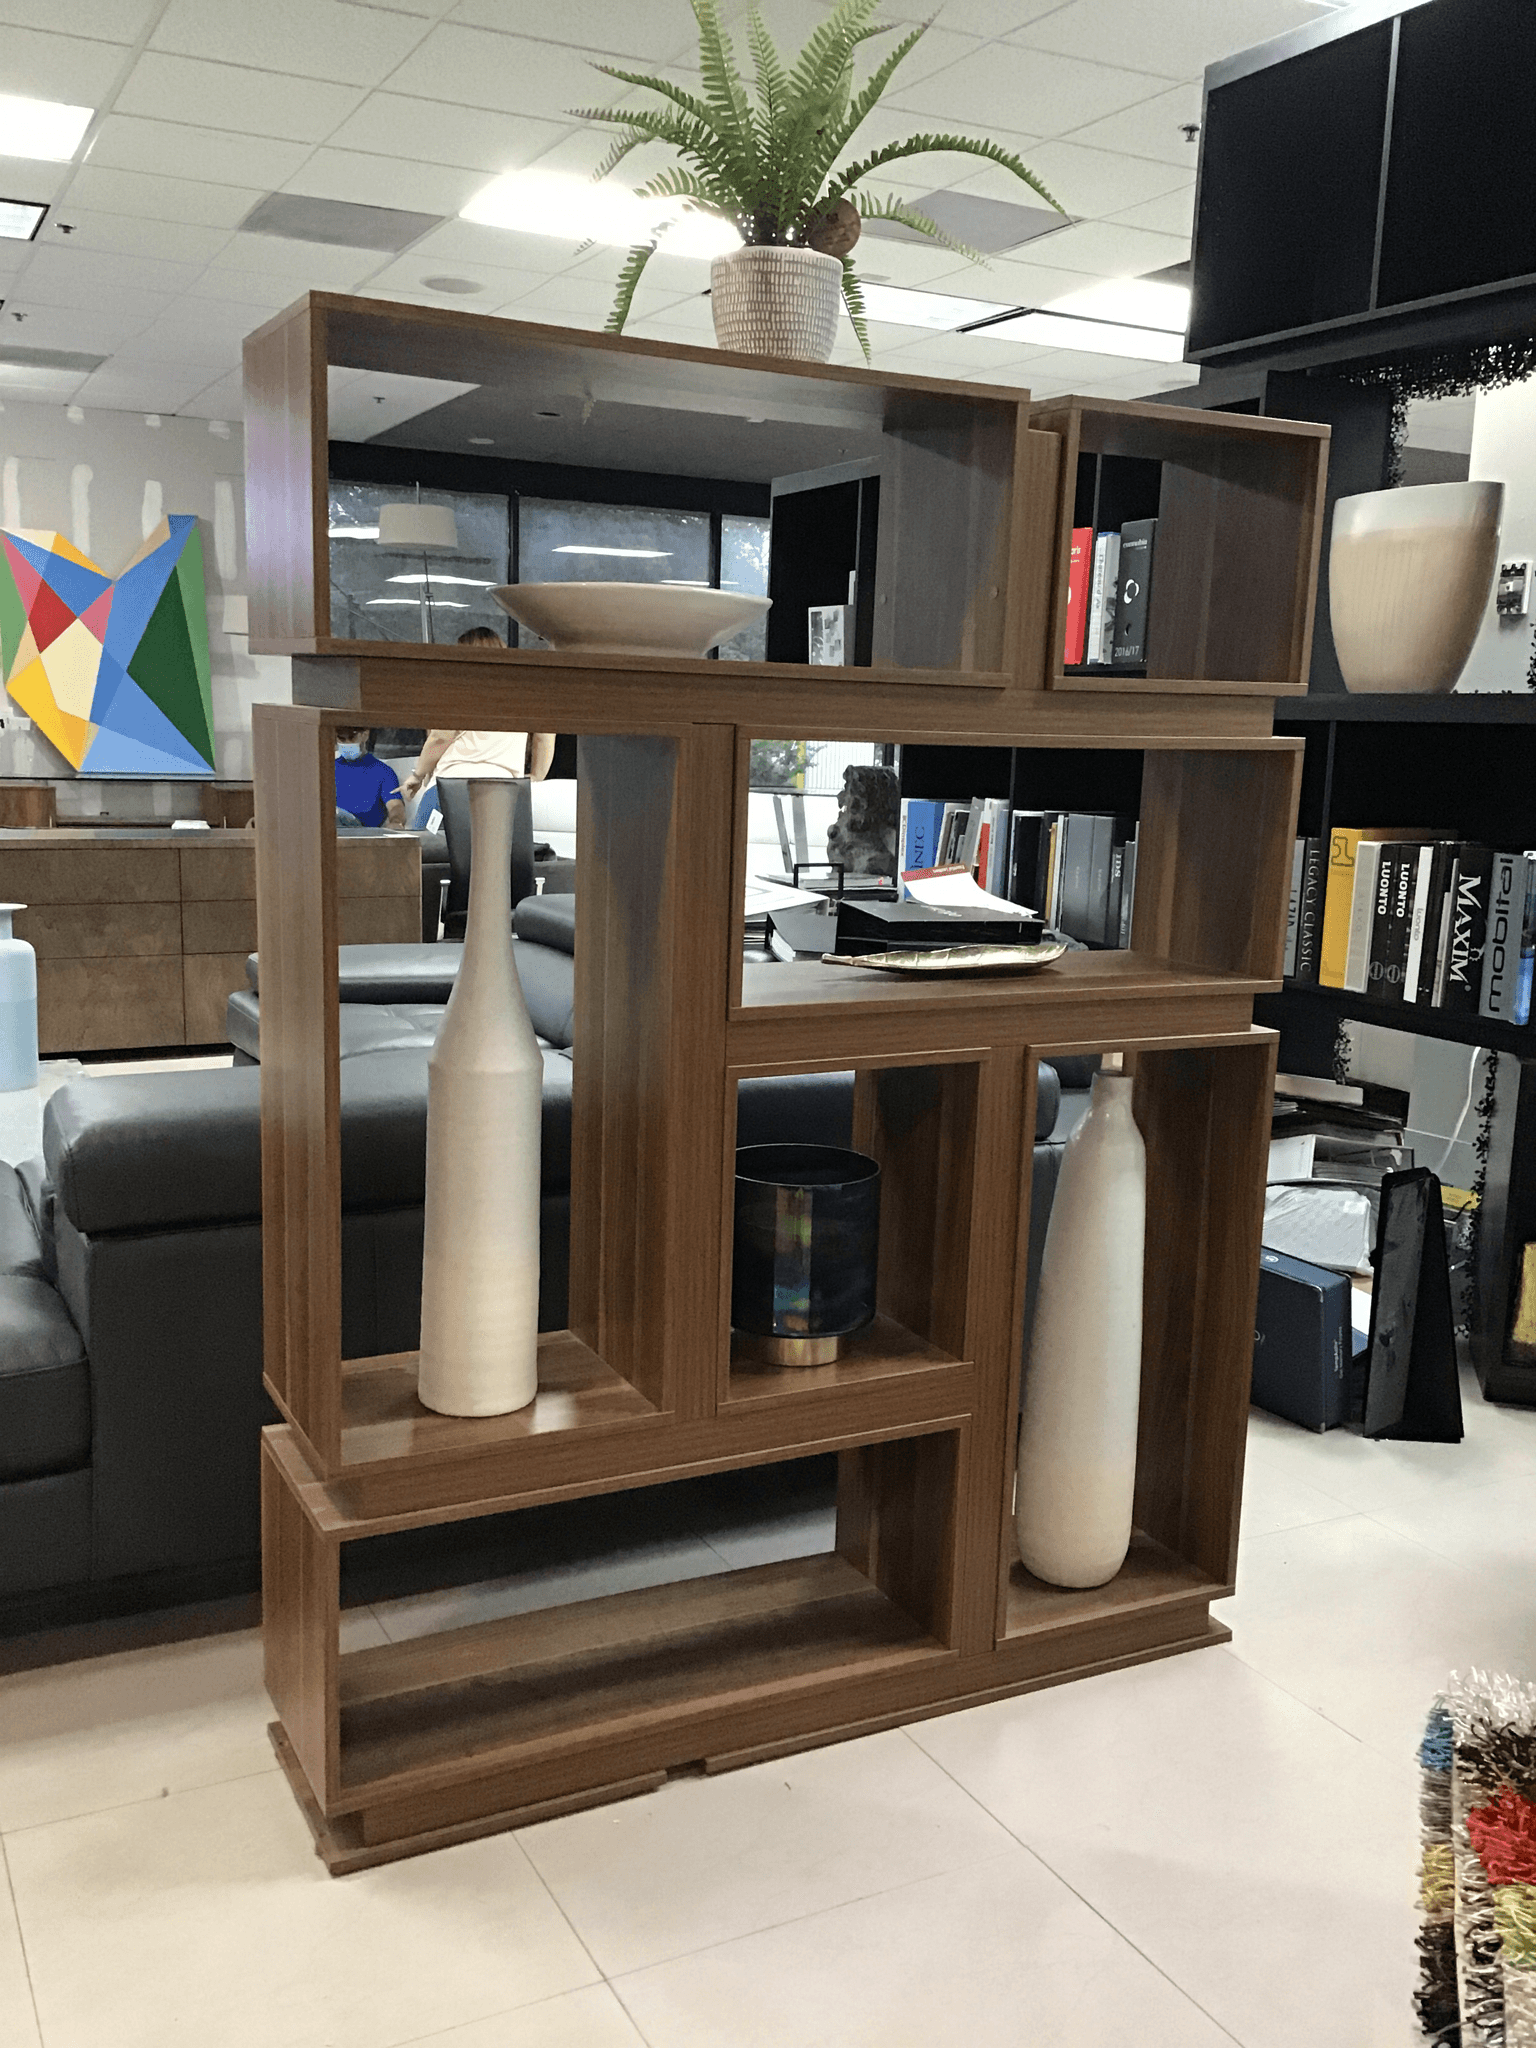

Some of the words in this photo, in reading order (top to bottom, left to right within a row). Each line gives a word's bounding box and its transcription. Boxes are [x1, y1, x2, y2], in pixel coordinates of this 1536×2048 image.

[1115, 646, 1140, 657] 2016/17
[1305, 849, 1320, 907] LEGACY
[1377, 861, 1392, 915] LUONTO
[1396, 863, 1411, 918] LUONTO
[1300, 911, 1316, 973] CLASSIC
[1414, 907, 1424, 941] luonto
[1449, 873, 1482, 984] MAXIM
[1489, 857, 1513, 1013] mobital
